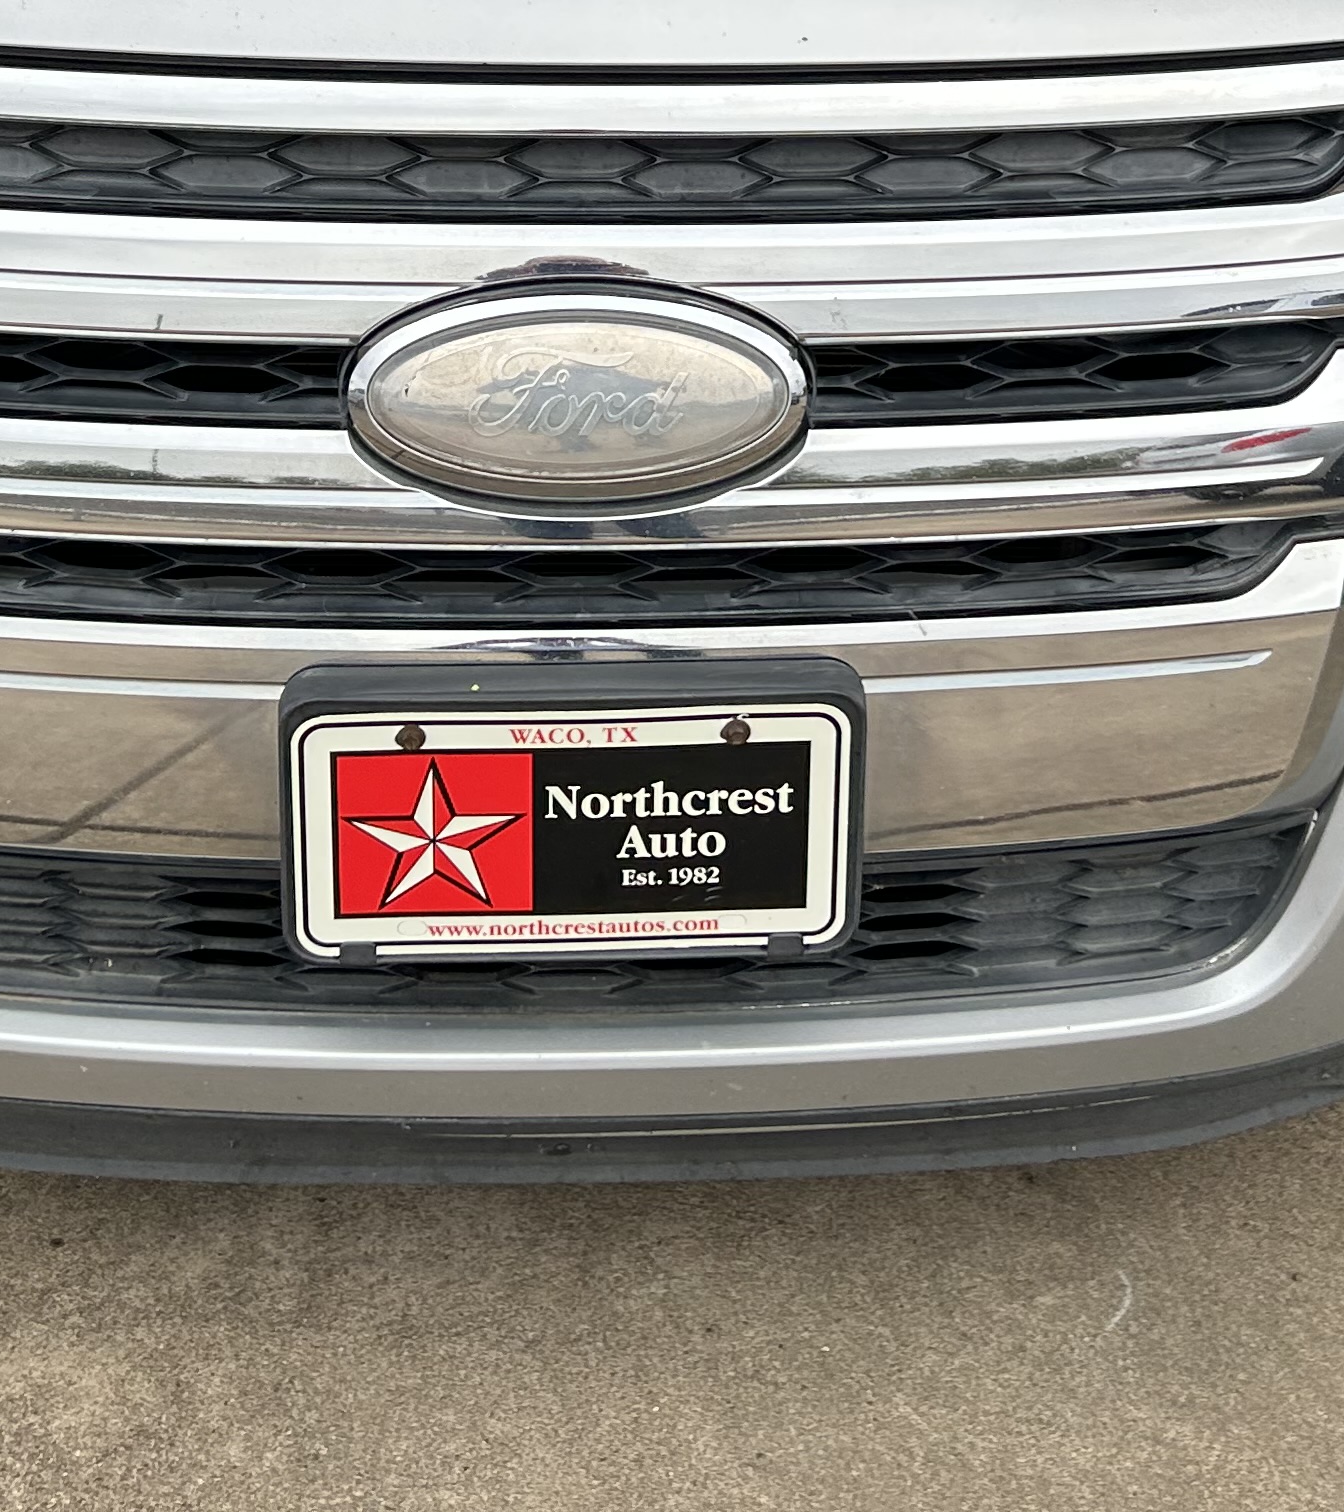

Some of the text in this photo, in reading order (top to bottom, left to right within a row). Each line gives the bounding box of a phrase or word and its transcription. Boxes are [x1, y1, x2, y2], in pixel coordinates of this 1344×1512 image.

[468, 346, 690, 439] Ford
[509, 726, 638, 748] WACO, TX
[544, 780, 795, 820] Northcrest
[616, 824, 727, 859] Auto
[621, 866, 721, 887] Est. 1982
[427, 918, 720, 937] www.northcrestautos.com
